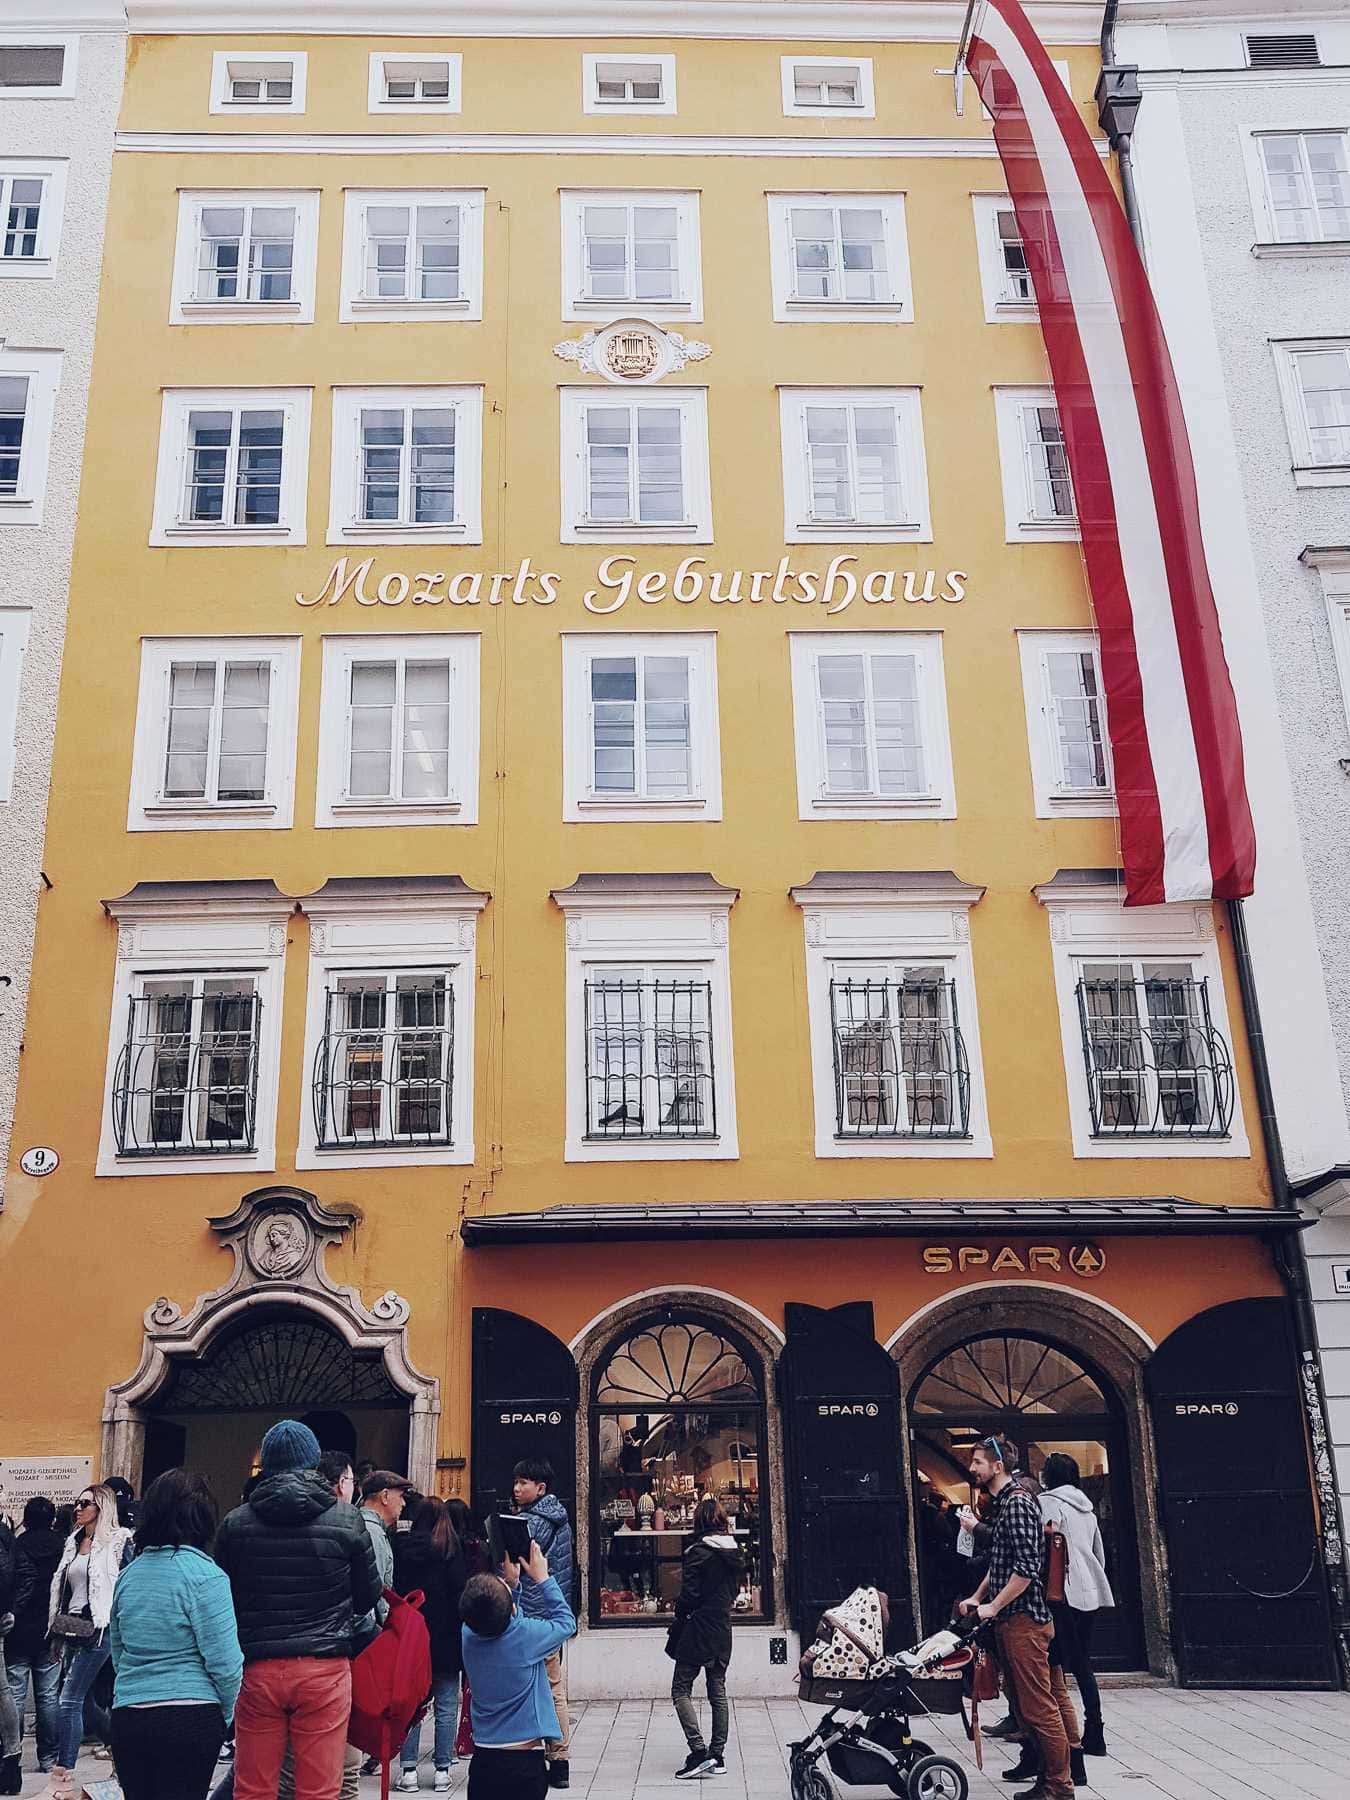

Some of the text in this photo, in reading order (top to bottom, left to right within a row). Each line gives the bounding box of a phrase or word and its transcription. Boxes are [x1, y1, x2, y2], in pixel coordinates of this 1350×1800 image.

[295, 554, 968, 616] Mozarts Geburtshaus
[34, 1150, 45, 1167] 9
[923, 1247, 1061, 1273] SPAR
[818, 1405, 864, 1416] SPAR
[1175, 1404, 1222, 1415] SPAR
[500, 1413, 546, 1424] SPAR
